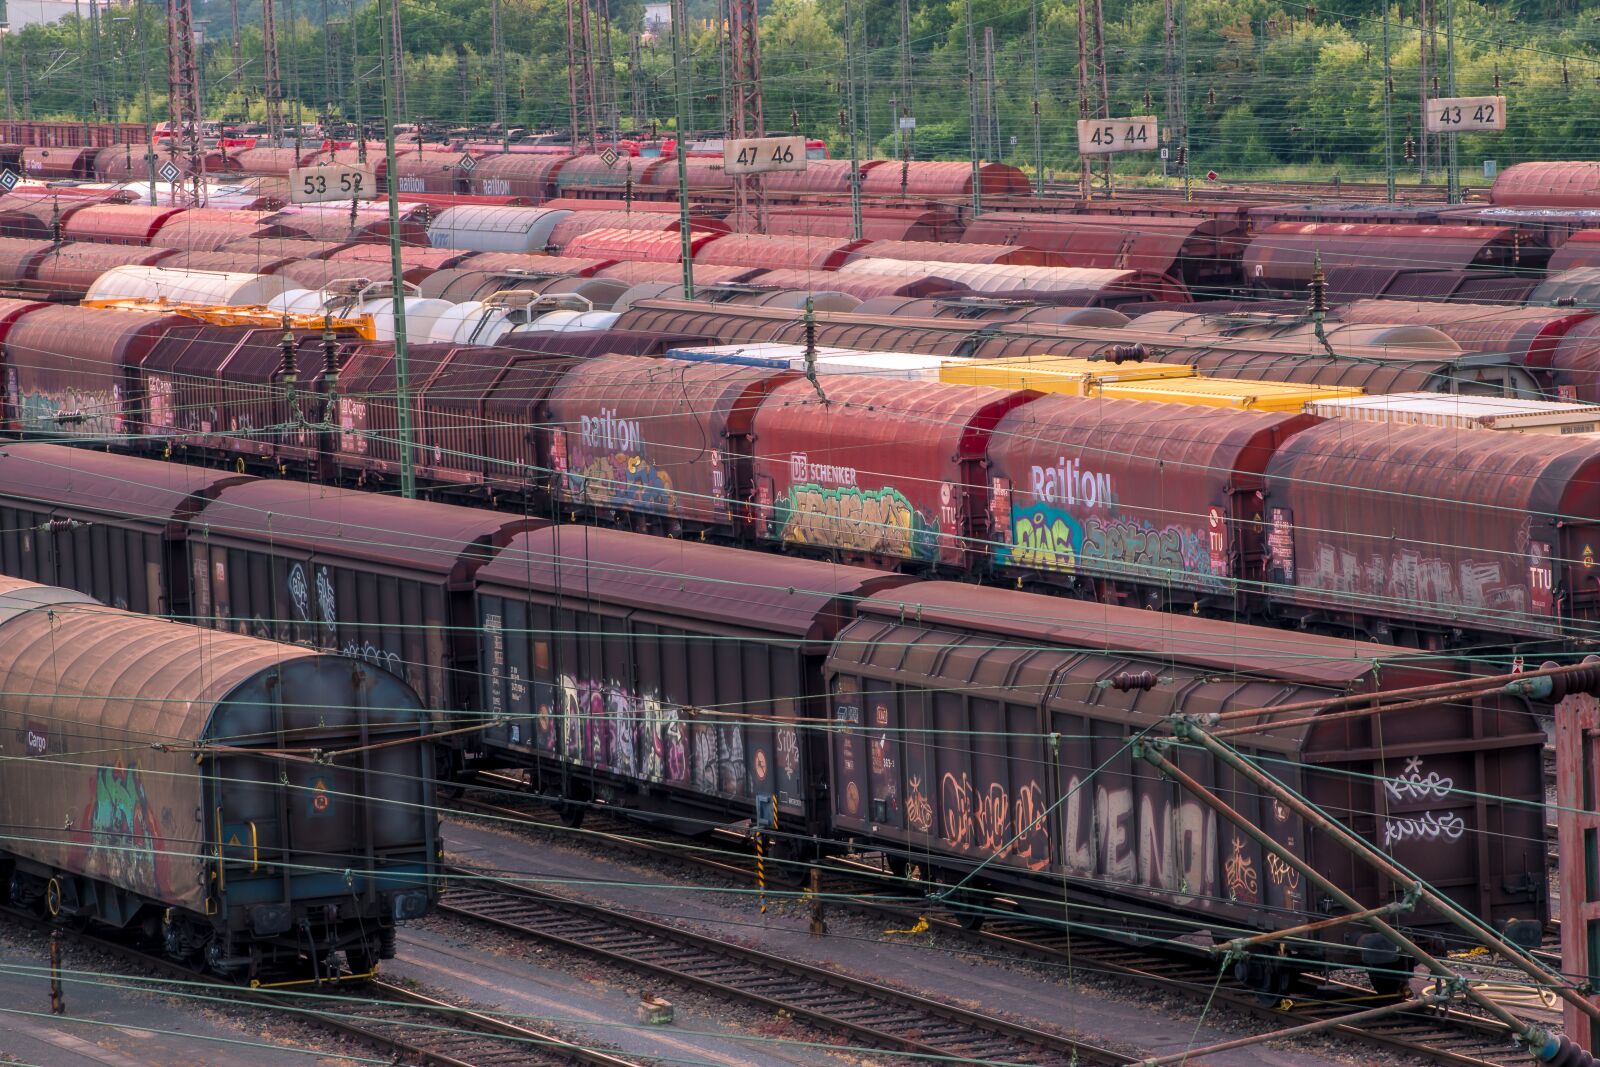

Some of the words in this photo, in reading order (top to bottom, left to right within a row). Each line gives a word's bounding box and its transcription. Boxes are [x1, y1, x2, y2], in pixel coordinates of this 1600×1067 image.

[1440, 106, 1461, 124] 43
[1473, 105, 1494, 123] 42
[1091, 127, 1114, 145] 45
[1125, 125, 1147, 143] 44
[736, 147, 758, 165] 47
[771, 145, 793, 164] 46
[304, 175, 326, 194] 53
[340, 172, 363, 192] 52
[792, 455, 807, 481] DB
[810, 463, 857, 484] SCHENKER
[941, 506, 956, 524] TTU
[1210, 531, 1223, 551] TTU
[1530, 567, 1552, 590] TTU
[28, 731, 46, 752] Cargo
